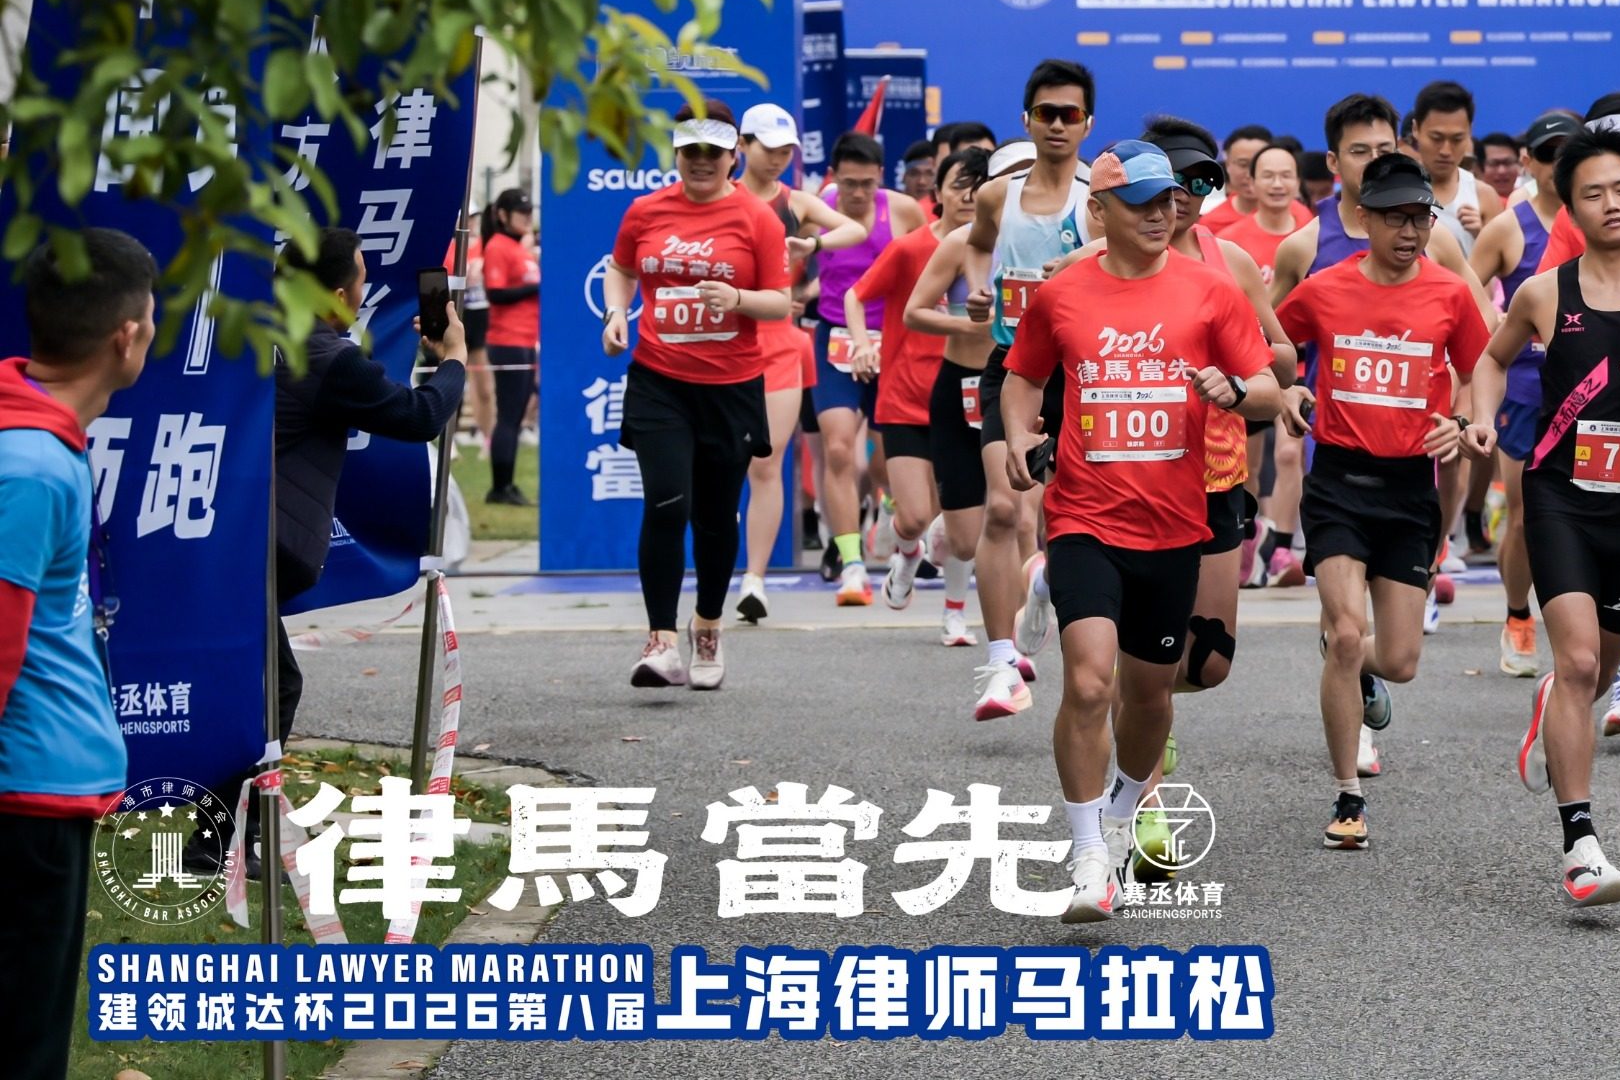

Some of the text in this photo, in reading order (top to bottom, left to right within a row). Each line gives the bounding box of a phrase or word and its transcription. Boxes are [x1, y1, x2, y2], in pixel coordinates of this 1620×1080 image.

[641, 256, 736, 280] 律馬當先
[1098, 323, 1165, 358] 2026
[1077, 358, 1192, 384] 律馬當先
[1355, 357, 1409, 386] 601
[1105, 410, 1169, 438] 100
